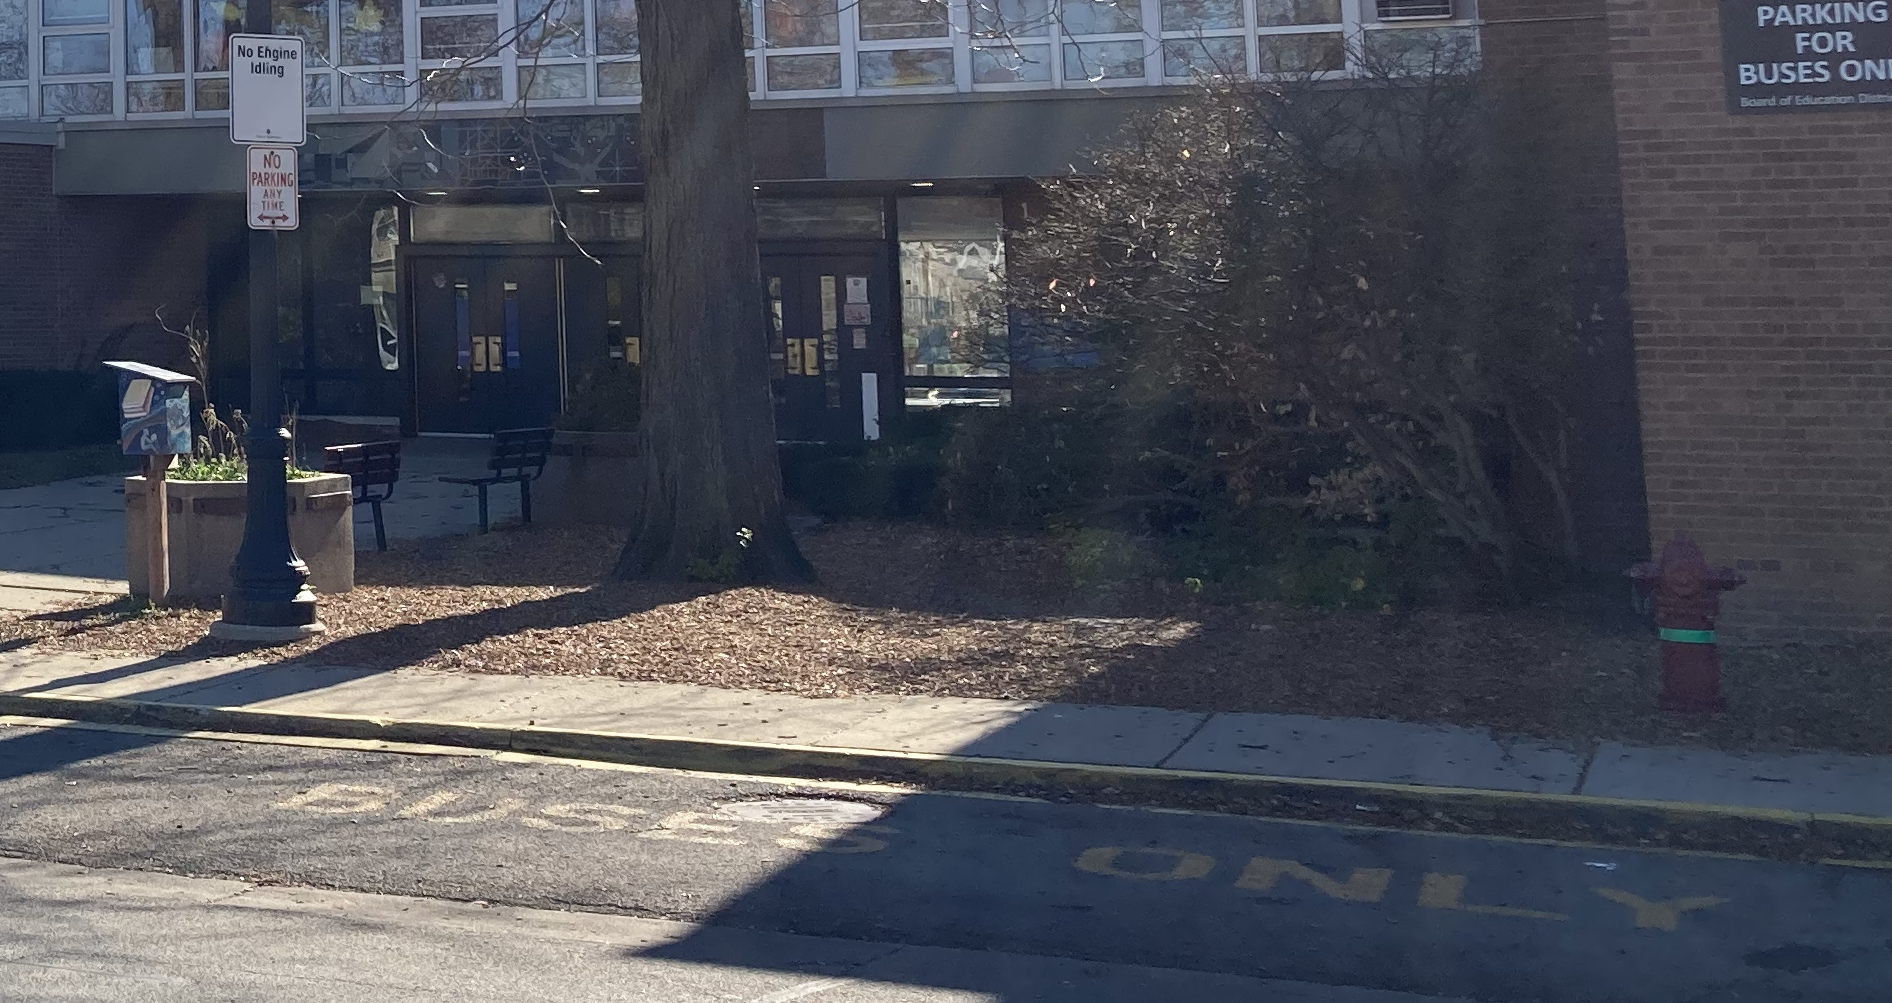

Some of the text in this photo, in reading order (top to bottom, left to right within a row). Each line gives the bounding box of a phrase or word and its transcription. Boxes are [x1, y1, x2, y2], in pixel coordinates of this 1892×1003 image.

[1757, 0, 1889, 27] PARKING
[1795, 31, 1856, 54] FOR
[237, 45, 298, 62] No Engine
[250, 61, 285, 77] Idling
[1739, 61, 1831, 85] BUSES
[263, 154, 281, 169] NO
[251, 172, 294, 187] PARKING
[263, 189, 283, 199] ANY
[262, 200, 285, 212] TIME
[274, 783, 892, 855] BUSES
[1074, 846, 1730, 932] ONLY
